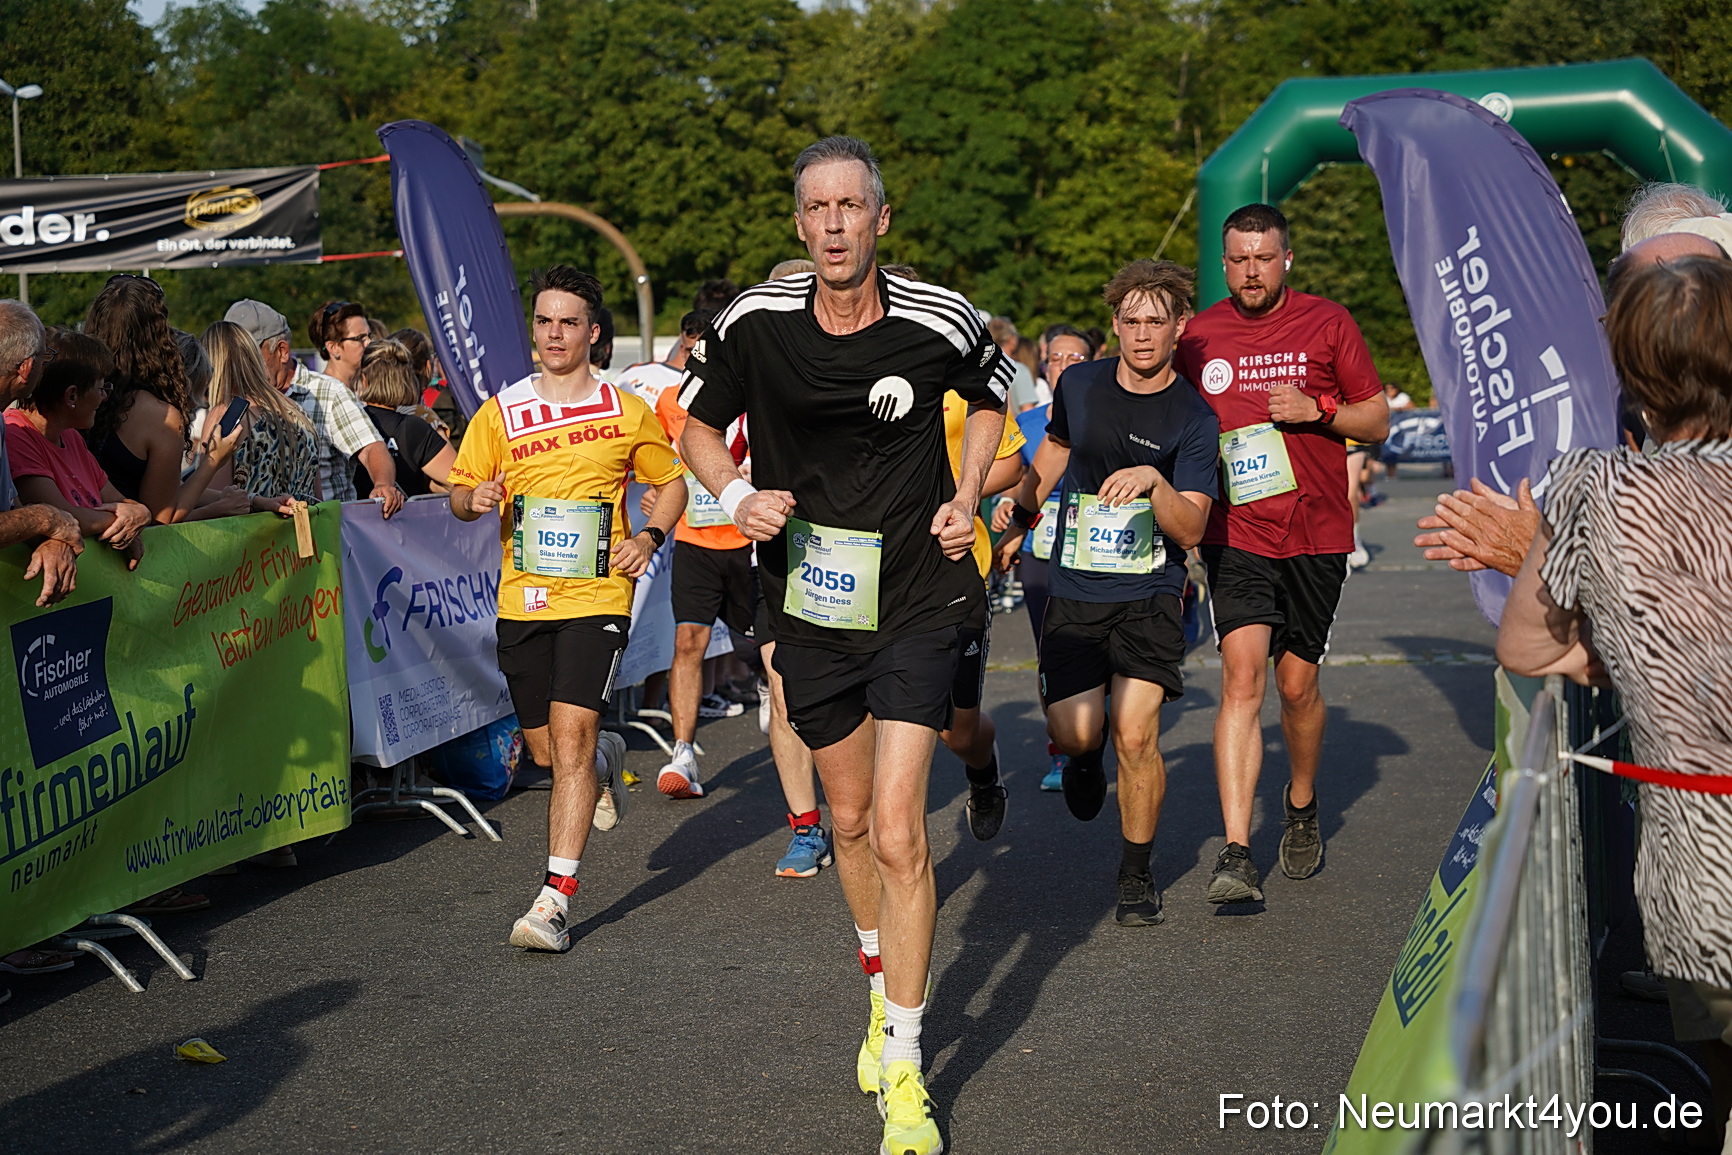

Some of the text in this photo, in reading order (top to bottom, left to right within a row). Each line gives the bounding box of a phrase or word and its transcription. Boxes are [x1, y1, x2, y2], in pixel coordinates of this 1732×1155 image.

[156, 236, 296, 252] Ein Ort, der verbindet.
[1238, 352, 1308, 367] KIRSCH &
[1209, 373, 1224, 386] KH
[511, 424, 627, 463] MAX BÖGL
[1230, 453, 1268, 476] 1247
[1231, 476, 1258, 488] Johannes
[1258, 469, 1281, 481] Kirsch
[537, 529, 580, 549] 1697
[1089, 526, 1136, 545] 2473
[539, 549, 556, 558] Silas
[556, 551, 579, 560] Henke
[1090, 546, 1116, 555] Michael
[800, 561, 856, 593] 2059
[173, 548, 256, 629] Gesunde
[804, 587, 828, 603] Jürgen
[829, 595, 852, 606] Dess
[211, 607, 273, 671] laufen
[34, 647, 92, 689] Fischer
[43, 671, 90, 702] AUTOMOBILE
[0, 682, 197, 862] firmenlauf
[11, 818, 98, 893] neumarkt
